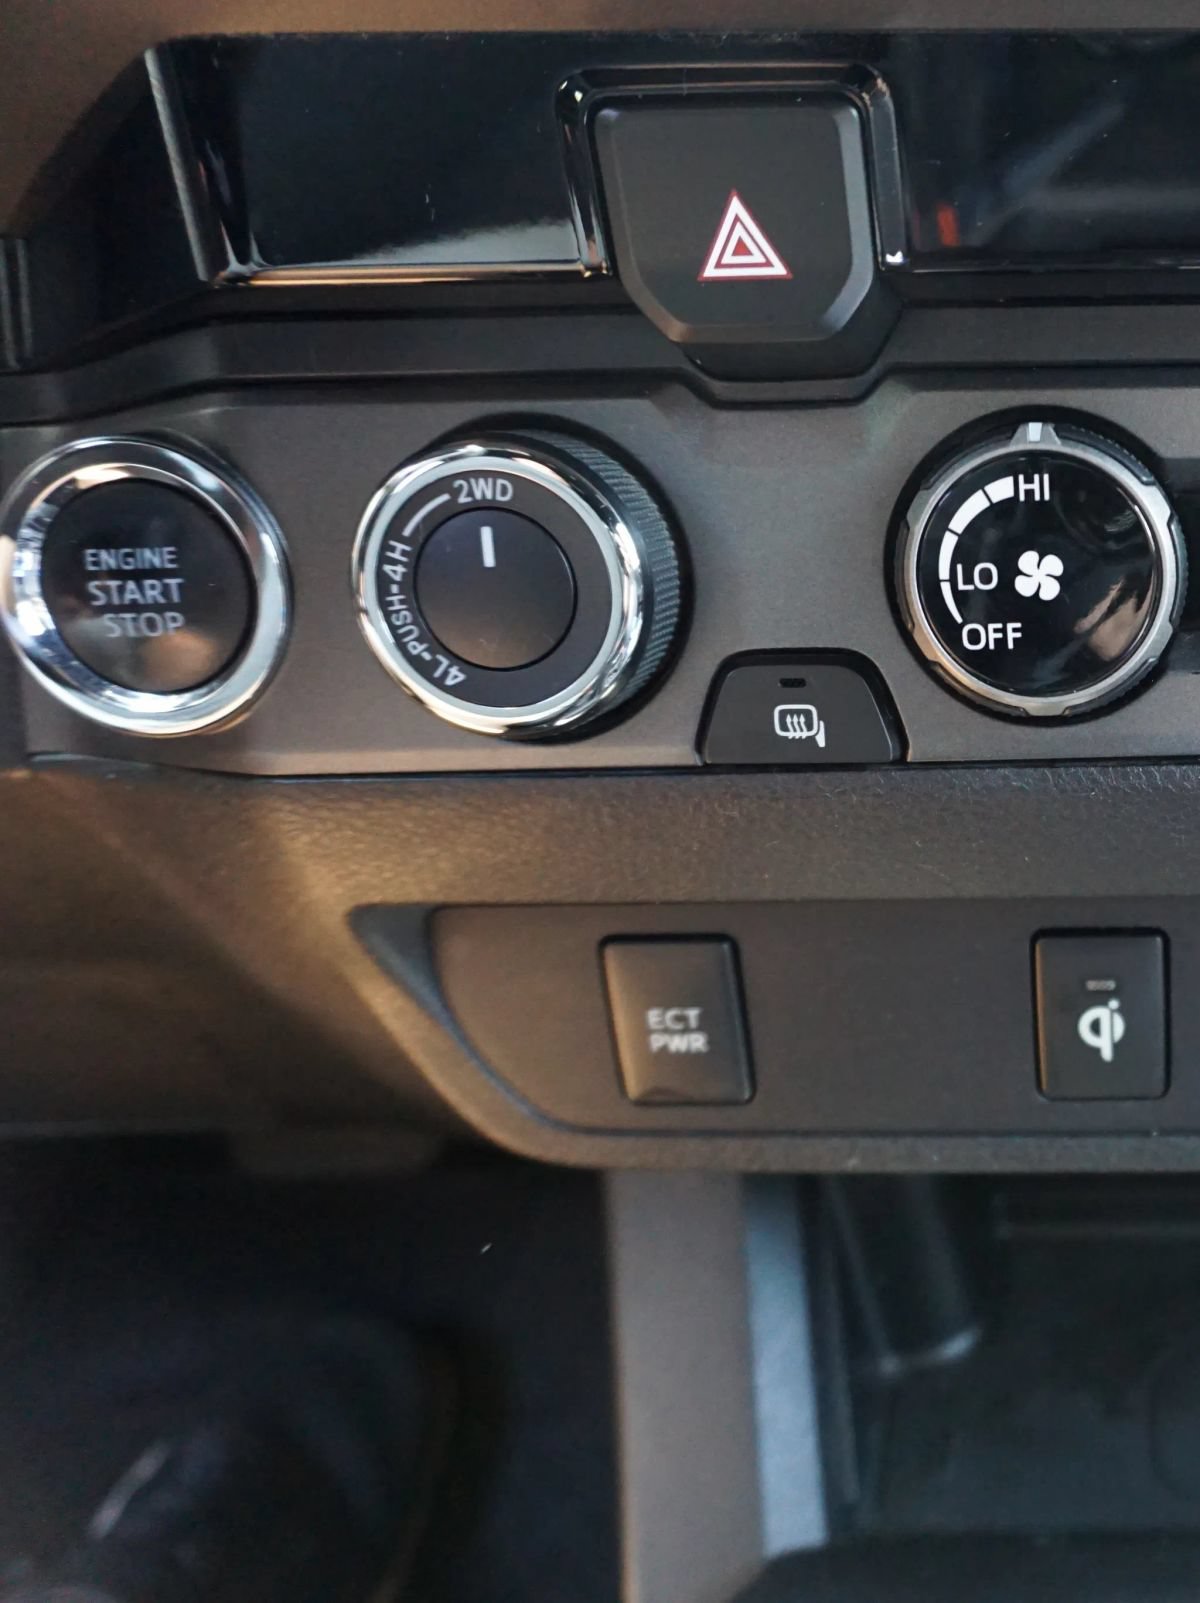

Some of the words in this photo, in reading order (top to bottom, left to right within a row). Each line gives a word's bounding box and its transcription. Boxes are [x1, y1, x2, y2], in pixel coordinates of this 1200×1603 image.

[453, 477, 514, 506] 2WD
[1018, 474, 1050, 502] HI
[85, 546, 177, 570] ENGINE
[956, 563, 998, 591] LO
[88, 579, 184, 605] START
[103, 610, 185, 637] STOP
[961, 622, 1023, 650] OFF
[646, 1008, 702, 1031] ECT
[649, 1033, 711, 1056] PWR
